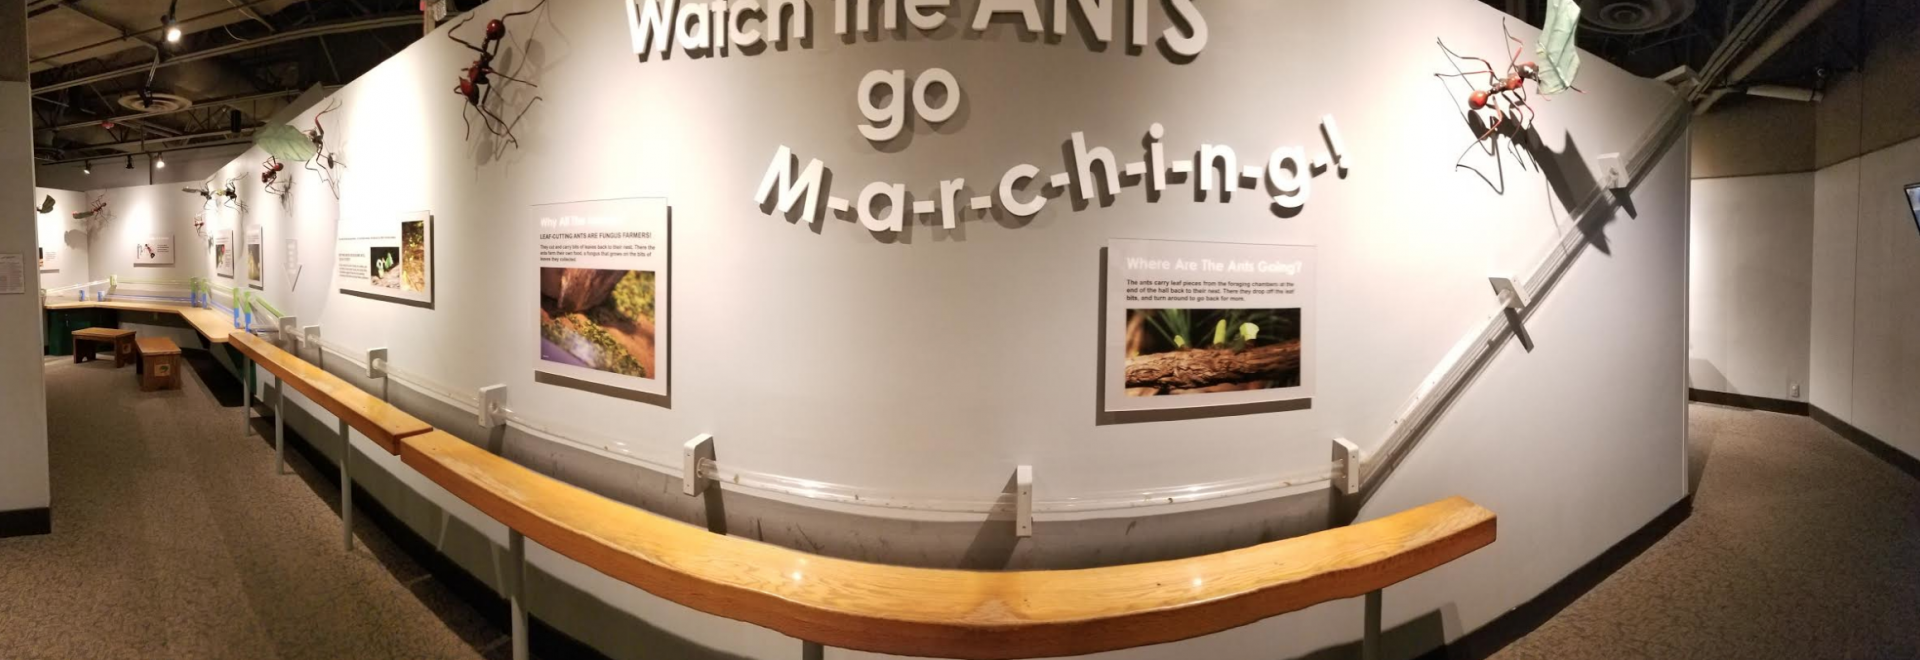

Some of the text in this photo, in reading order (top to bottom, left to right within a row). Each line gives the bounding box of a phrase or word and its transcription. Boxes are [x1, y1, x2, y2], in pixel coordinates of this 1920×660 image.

[625, 0, 806, 54] Watch
[857, 67, 960, 141] go
[1126, 257, 1303, 275] Where Are The Ants Going?
